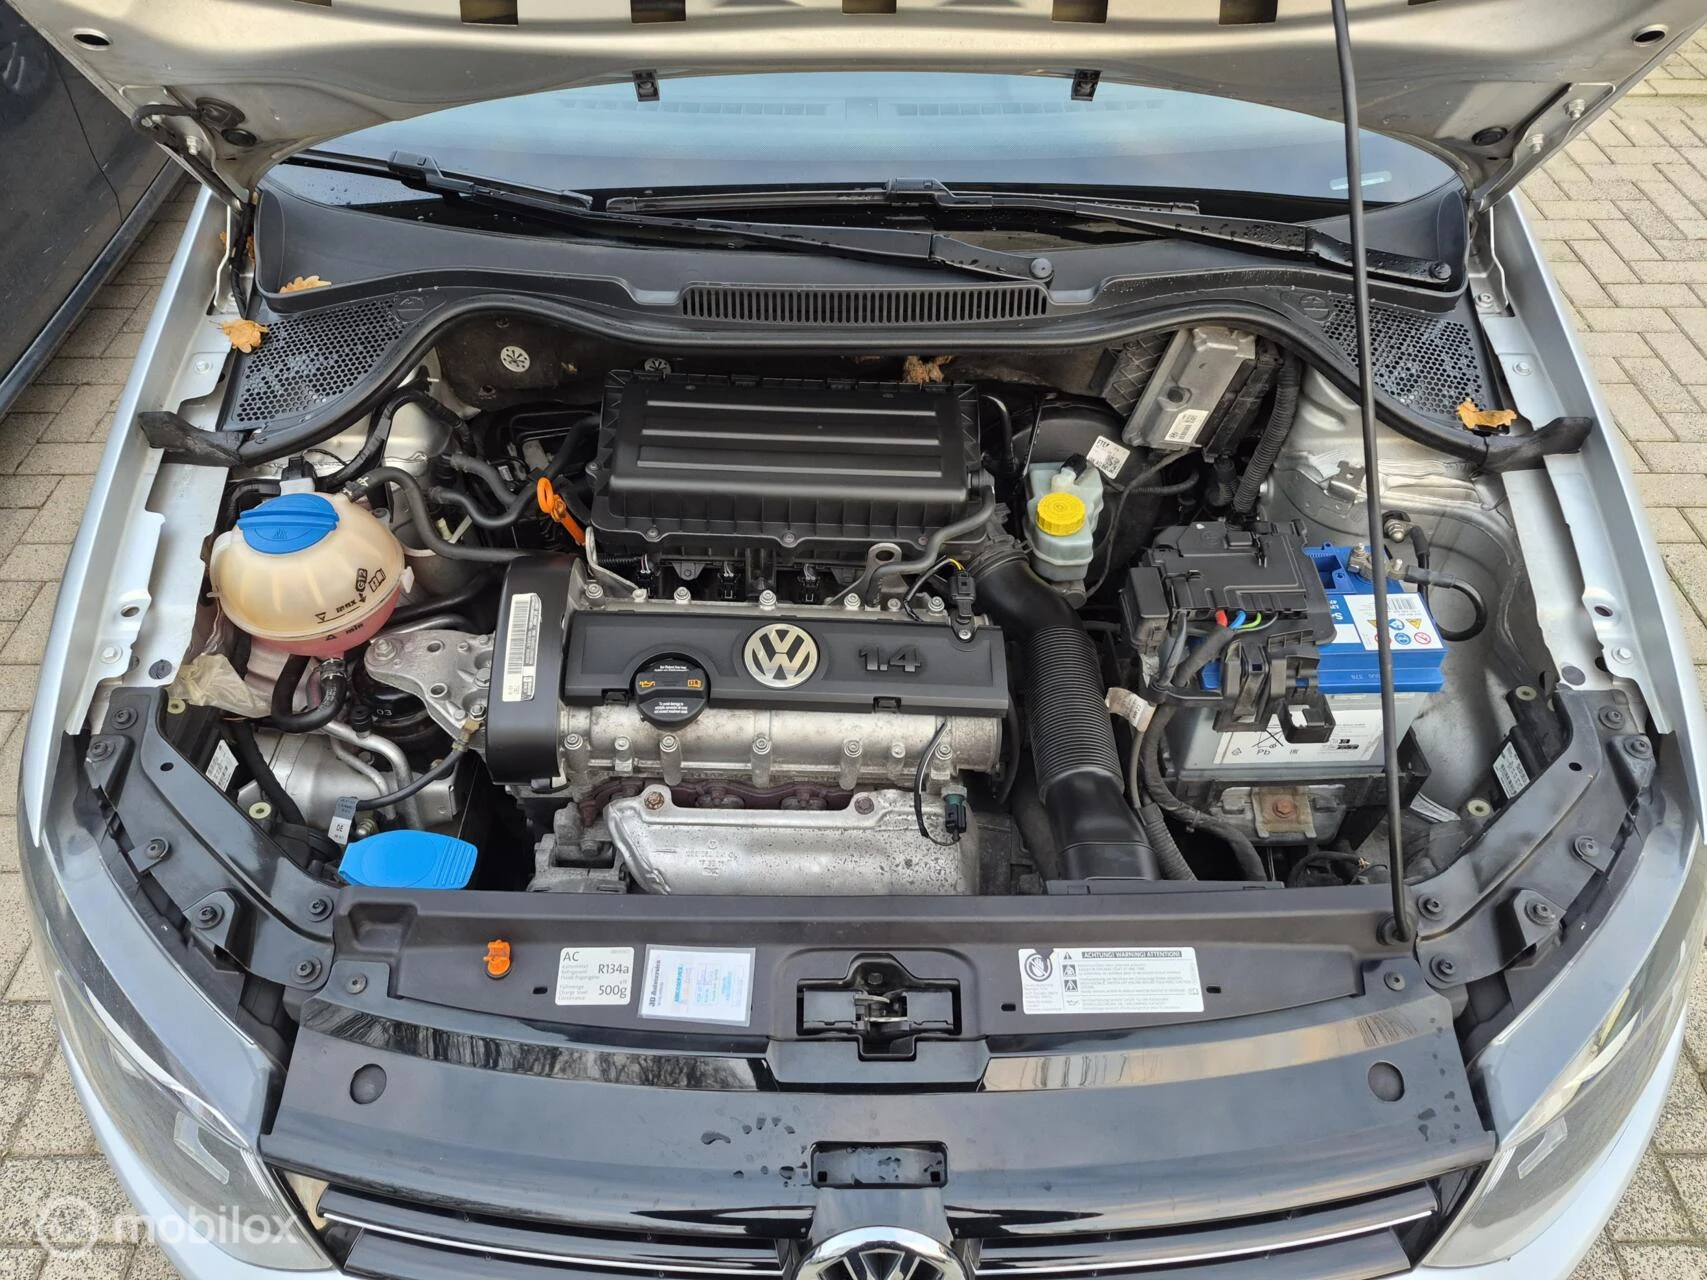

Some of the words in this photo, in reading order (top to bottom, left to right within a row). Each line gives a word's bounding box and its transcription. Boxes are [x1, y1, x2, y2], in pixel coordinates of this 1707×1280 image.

[336, 600, 356, 613] max
[858, 645, 921, 672] 1.4
[563, 951, 580, 962] AC
[598, 963, 629, 974] R134a
[599, 984, 627, 999] 500g
